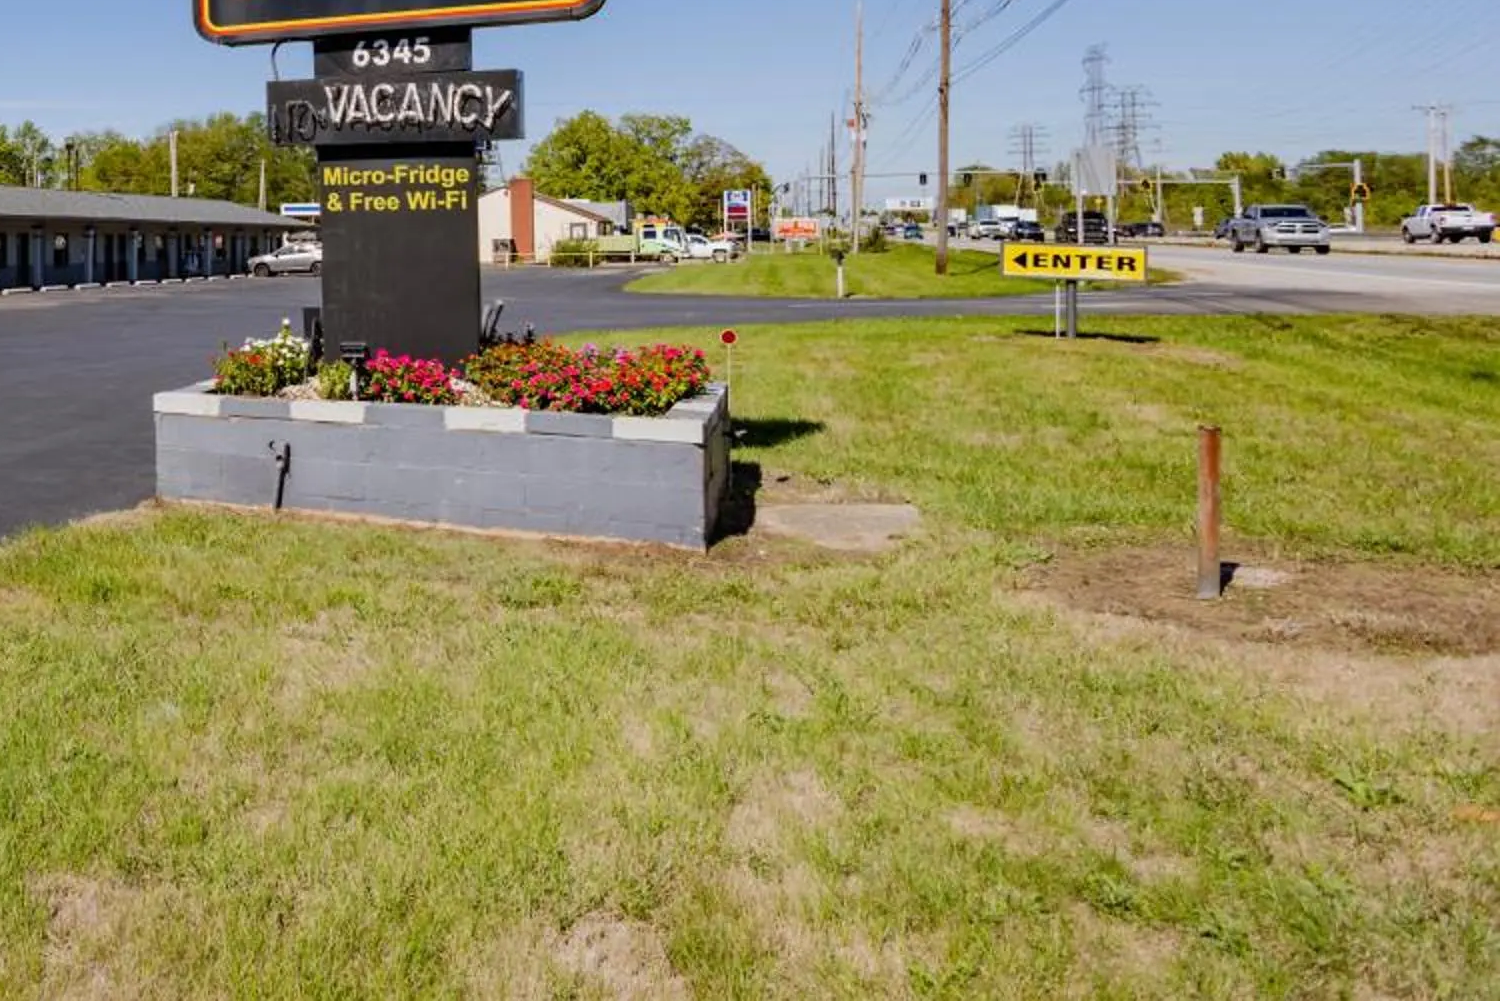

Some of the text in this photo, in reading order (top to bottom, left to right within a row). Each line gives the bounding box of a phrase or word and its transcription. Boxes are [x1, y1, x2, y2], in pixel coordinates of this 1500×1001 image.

[352, 37, 431, 67] 6345
[324, 82, 512, 129] VACANCY
[323, 165, 469, 187] Micro-Fridge
[327, 190, 468, 212] & Free Wi-Fi
[1032, 252, 1137, 272] ENTER
